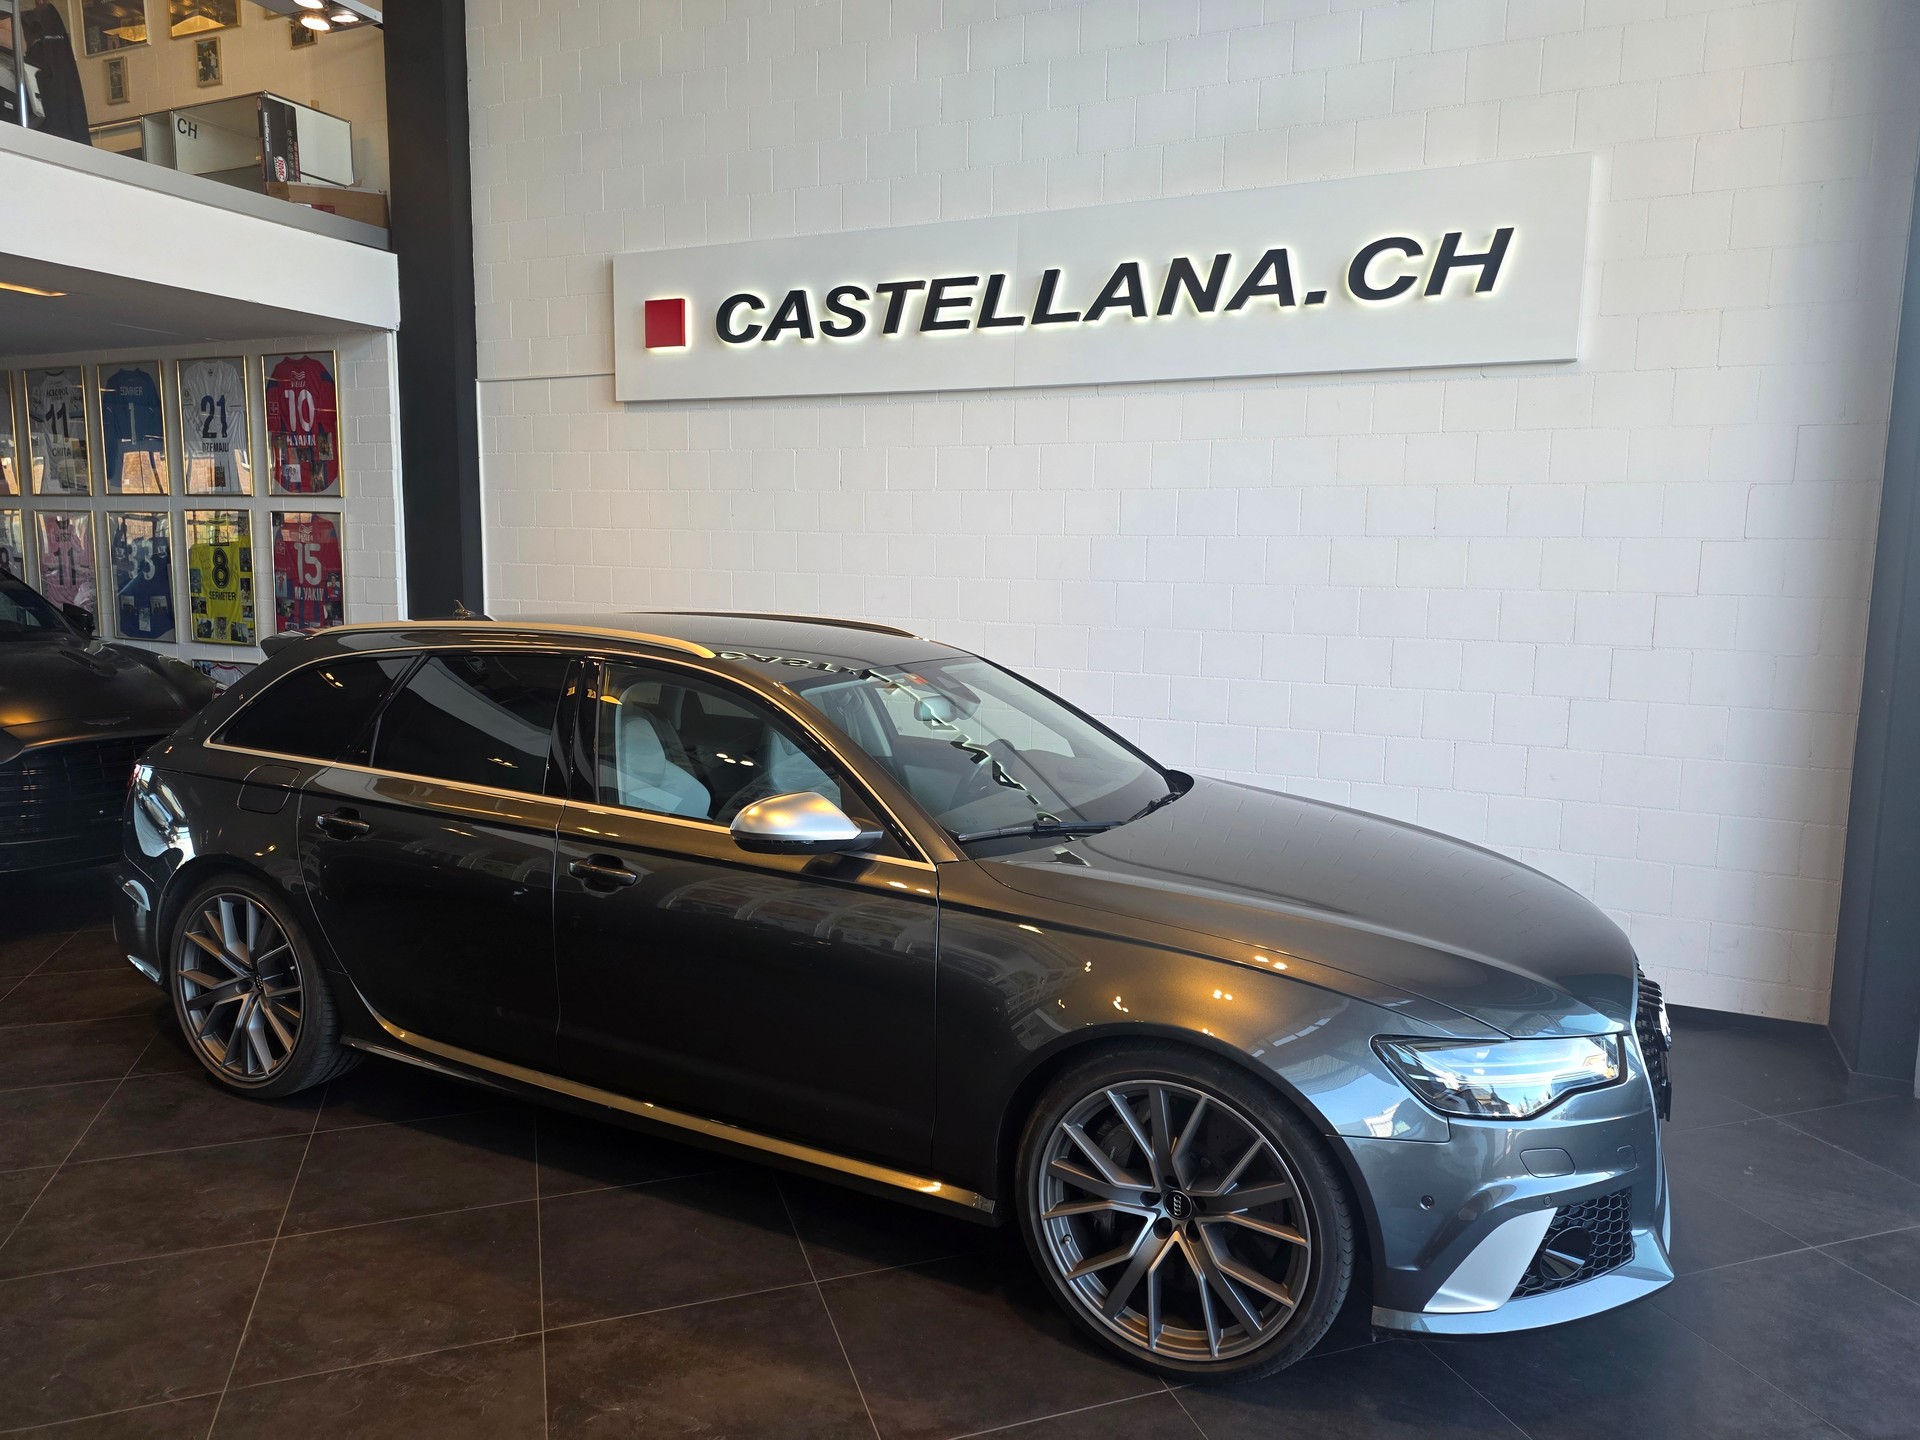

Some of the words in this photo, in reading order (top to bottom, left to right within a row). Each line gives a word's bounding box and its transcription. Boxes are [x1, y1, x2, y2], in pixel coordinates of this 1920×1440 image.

[177, 117, 197, 139] CH
[715, 227, 1515, 344] CASTELLANA.CH
[120, 386, 143, 396] SOMMER
[284, 389, 315, 432] 10
[45, 402, 69, 443] 11
[128, 403, 137, 445] 1
[201, 395, 227, 438] 21
[54, 547, 76, 586] 11
[212, 547, 229, 589] 8
[294, 543, 322, 586] 15
[208, 591, 236, 601] SERMETER
